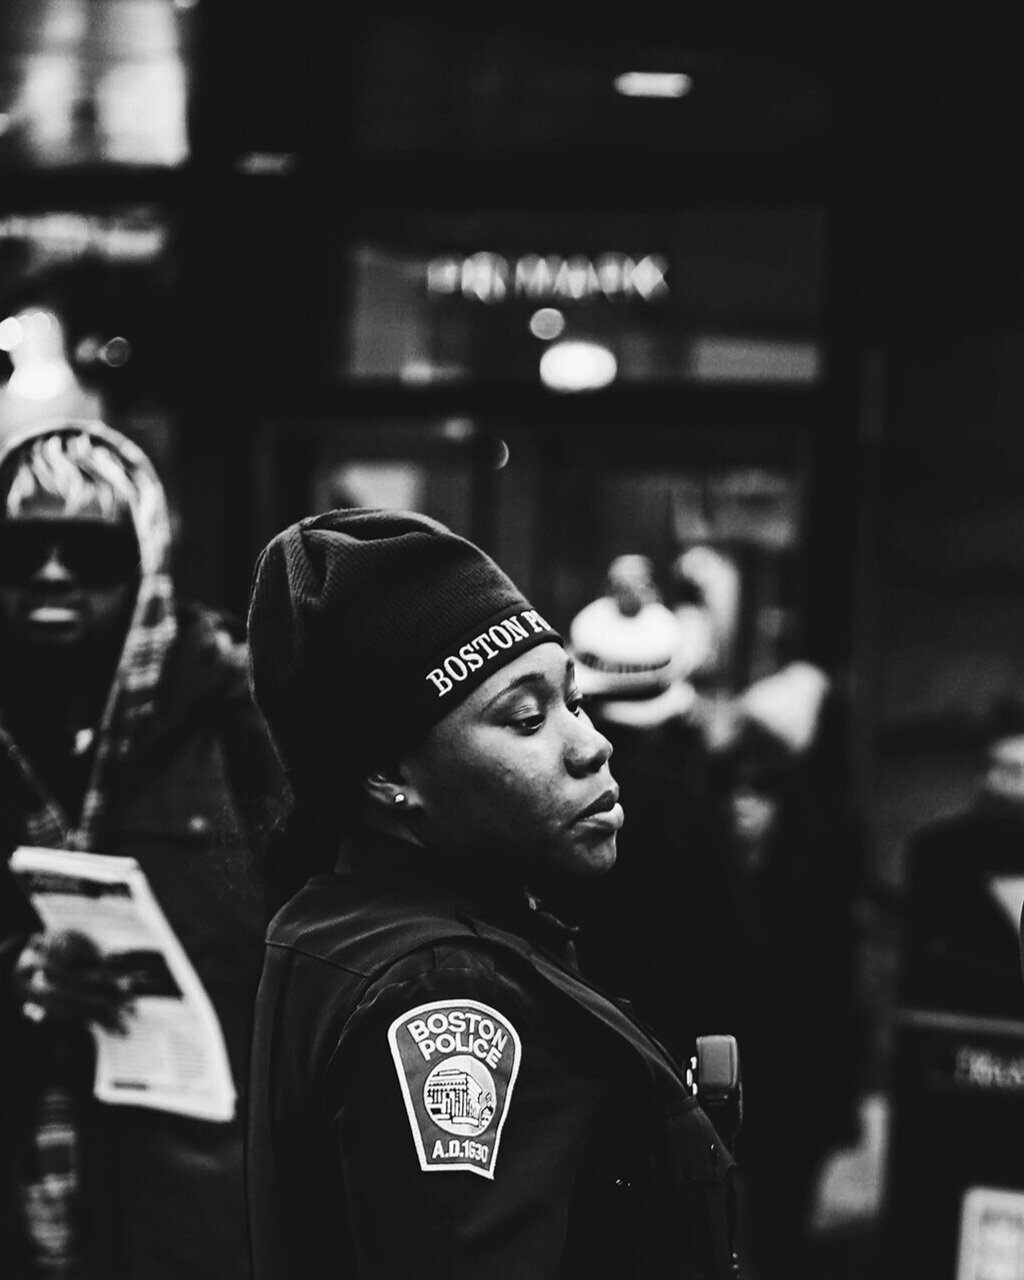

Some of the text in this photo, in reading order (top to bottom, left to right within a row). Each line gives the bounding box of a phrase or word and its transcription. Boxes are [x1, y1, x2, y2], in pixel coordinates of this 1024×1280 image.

[425, 609, 552, 697] BOSTON P
[406, 1011, 508, 1052] BOSTON
[417, 1032, 502, 1070] POLICE
[432, 1139, 489, 1163] A.D.1630
